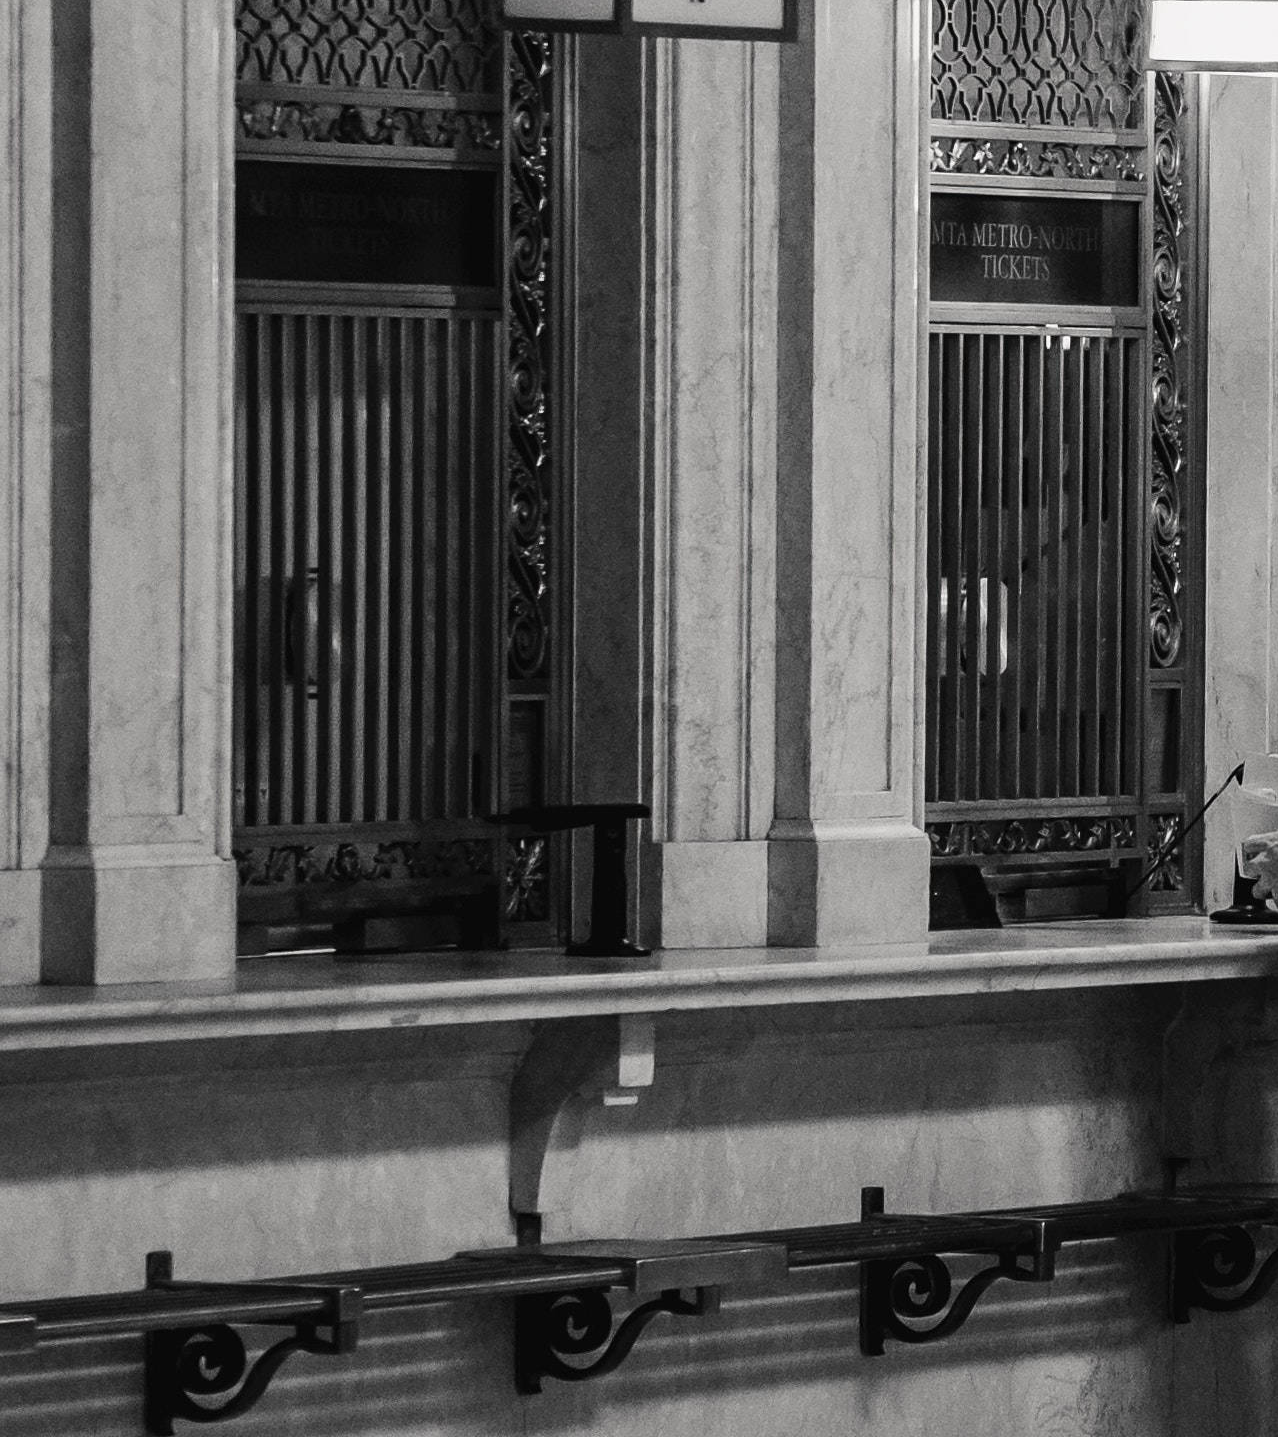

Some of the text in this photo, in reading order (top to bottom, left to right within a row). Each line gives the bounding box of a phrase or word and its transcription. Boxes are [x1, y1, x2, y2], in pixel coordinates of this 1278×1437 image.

[931, 221, 1099, 251] MTA METRO-NORTH
[981, 254, 1051, 280] TICKETS
